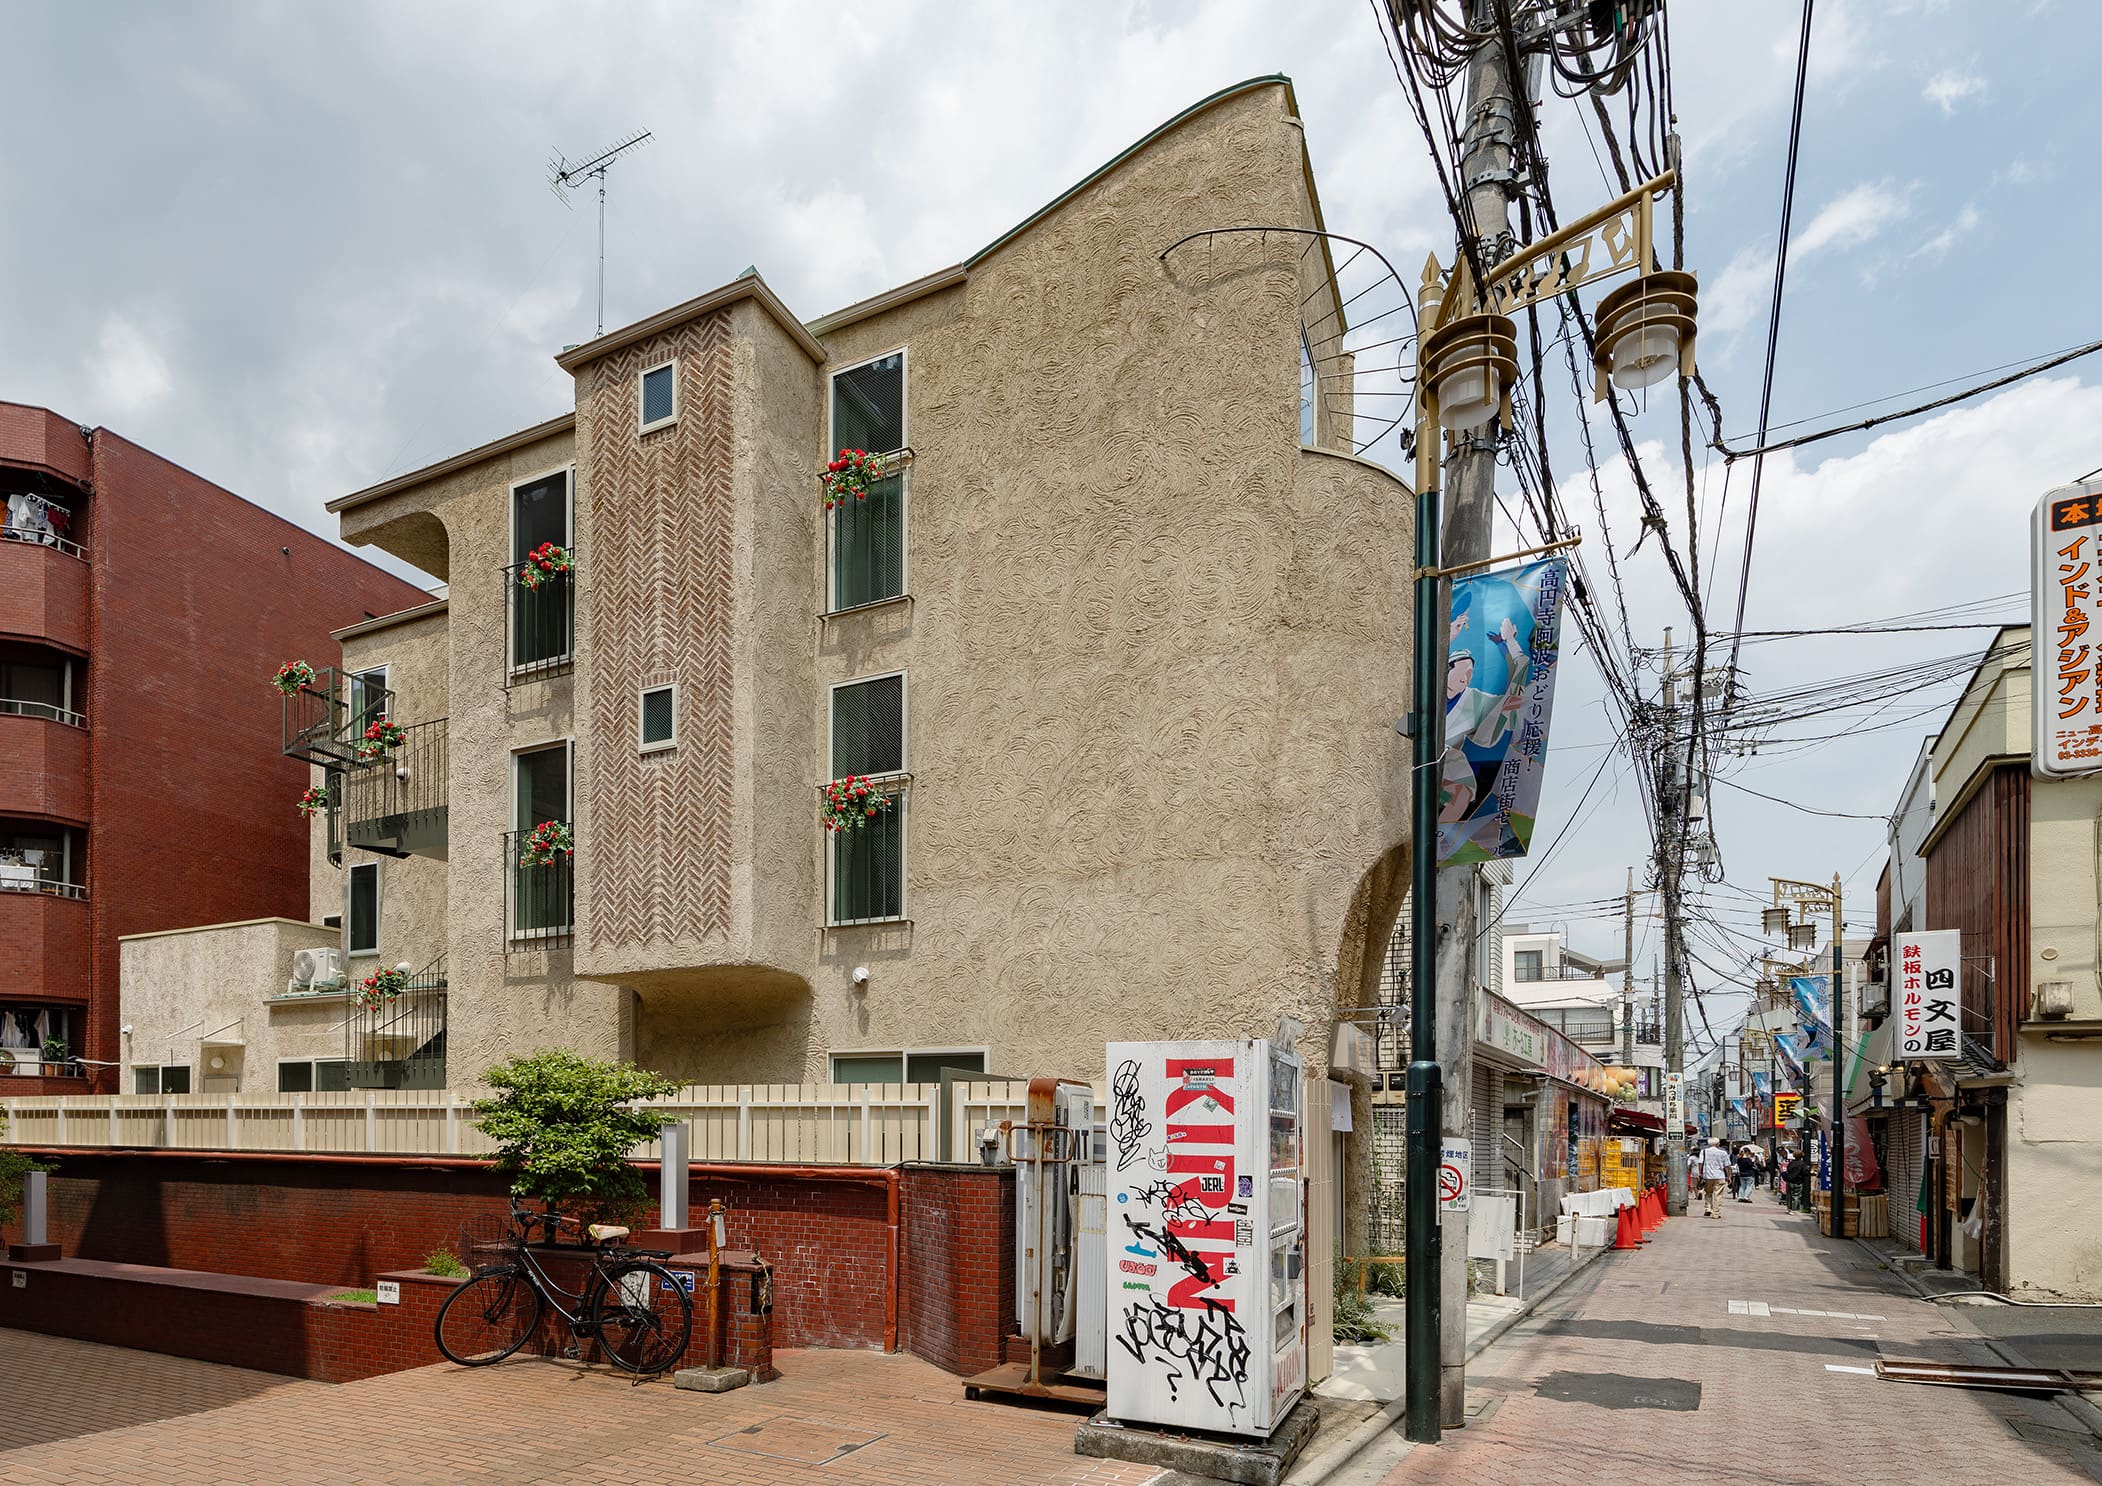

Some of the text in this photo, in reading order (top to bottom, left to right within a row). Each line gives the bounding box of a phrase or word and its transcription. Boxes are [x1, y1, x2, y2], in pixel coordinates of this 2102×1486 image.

[1523, 568, 1560, 772] 高円寺阿波おどり応援！
[2056, 535, 2091, 720] インド&アジアン
[1492, 758, 1520, 857] 商店街セール
[1902, 944, 1922, 1052] 鉄板ホルモンの
[1924, 968, 1957, 1052] 四文屋
[1166, 1057, 1235, 1311] KIRIN
[1276, 1346, 1300, 1399] KIRIN
